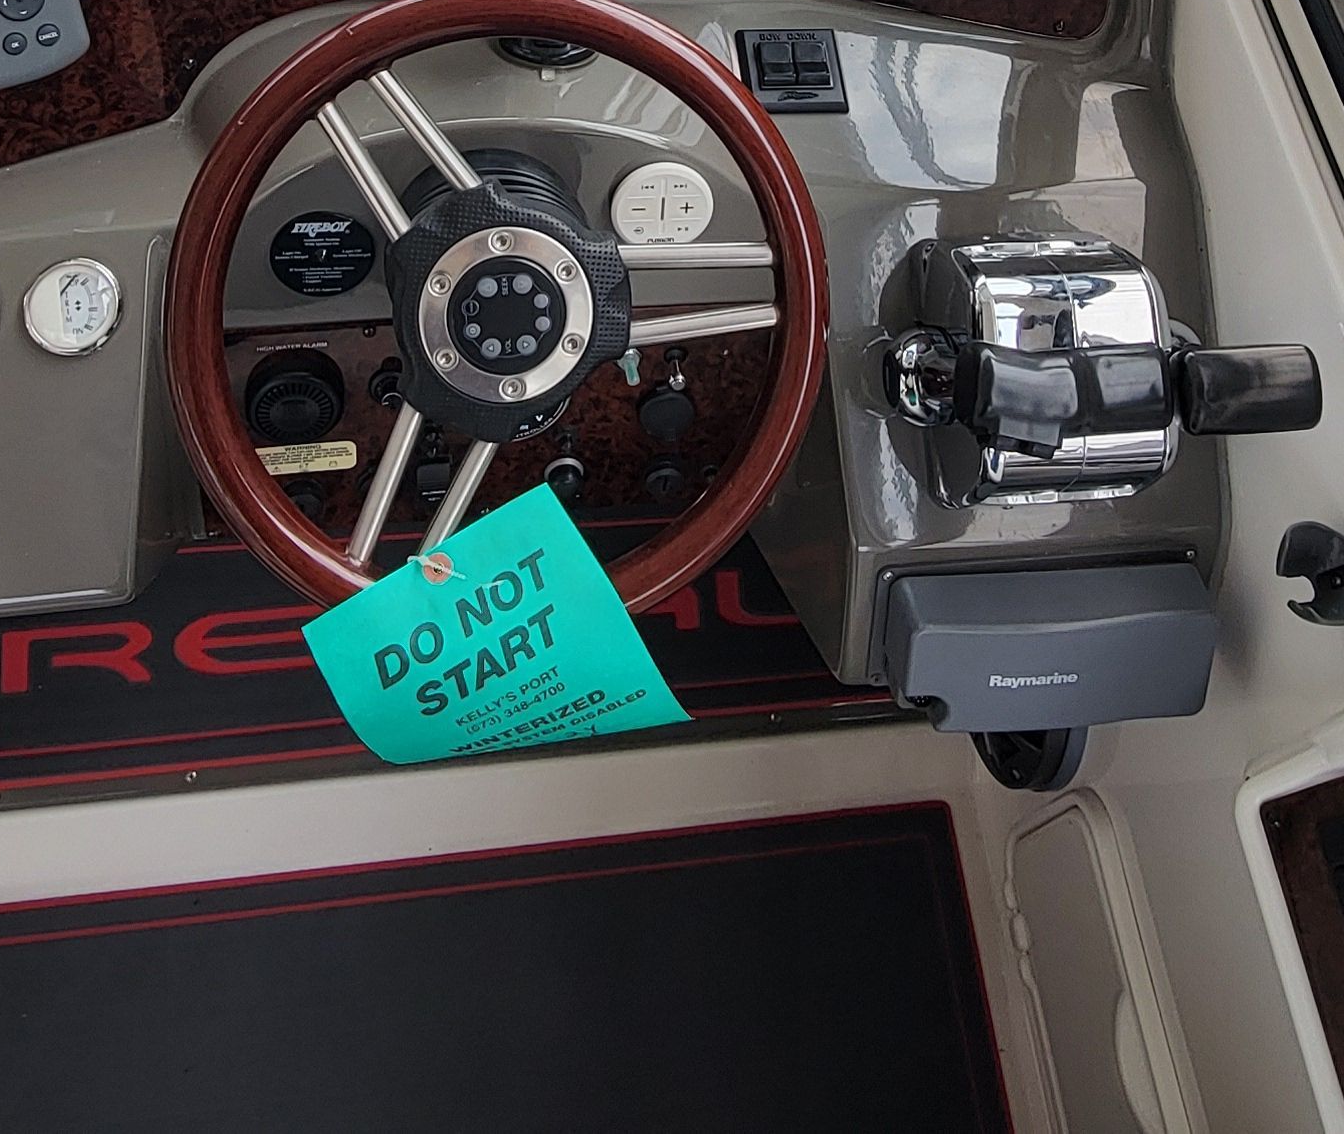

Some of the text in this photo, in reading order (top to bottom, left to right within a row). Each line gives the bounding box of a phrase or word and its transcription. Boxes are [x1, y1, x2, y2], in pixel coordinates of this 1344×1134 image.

[38, 31, 59, 42] CANCEL
[291, 221, 352, 237] FIREBOY
[501, 276, 509, 295] SEEK
[276, 343, 302, 351] WATER
[374, 548, 546, 690] DO NOT
[416, 604, 556, 716] START
[989, 672, 1078, 688] Raymarine
[456, 666, 560, 727] KELLY'S PORT
[571, 689, 647, 726] DISABLED
[449, 689, 606, 753] WINTERIZED
